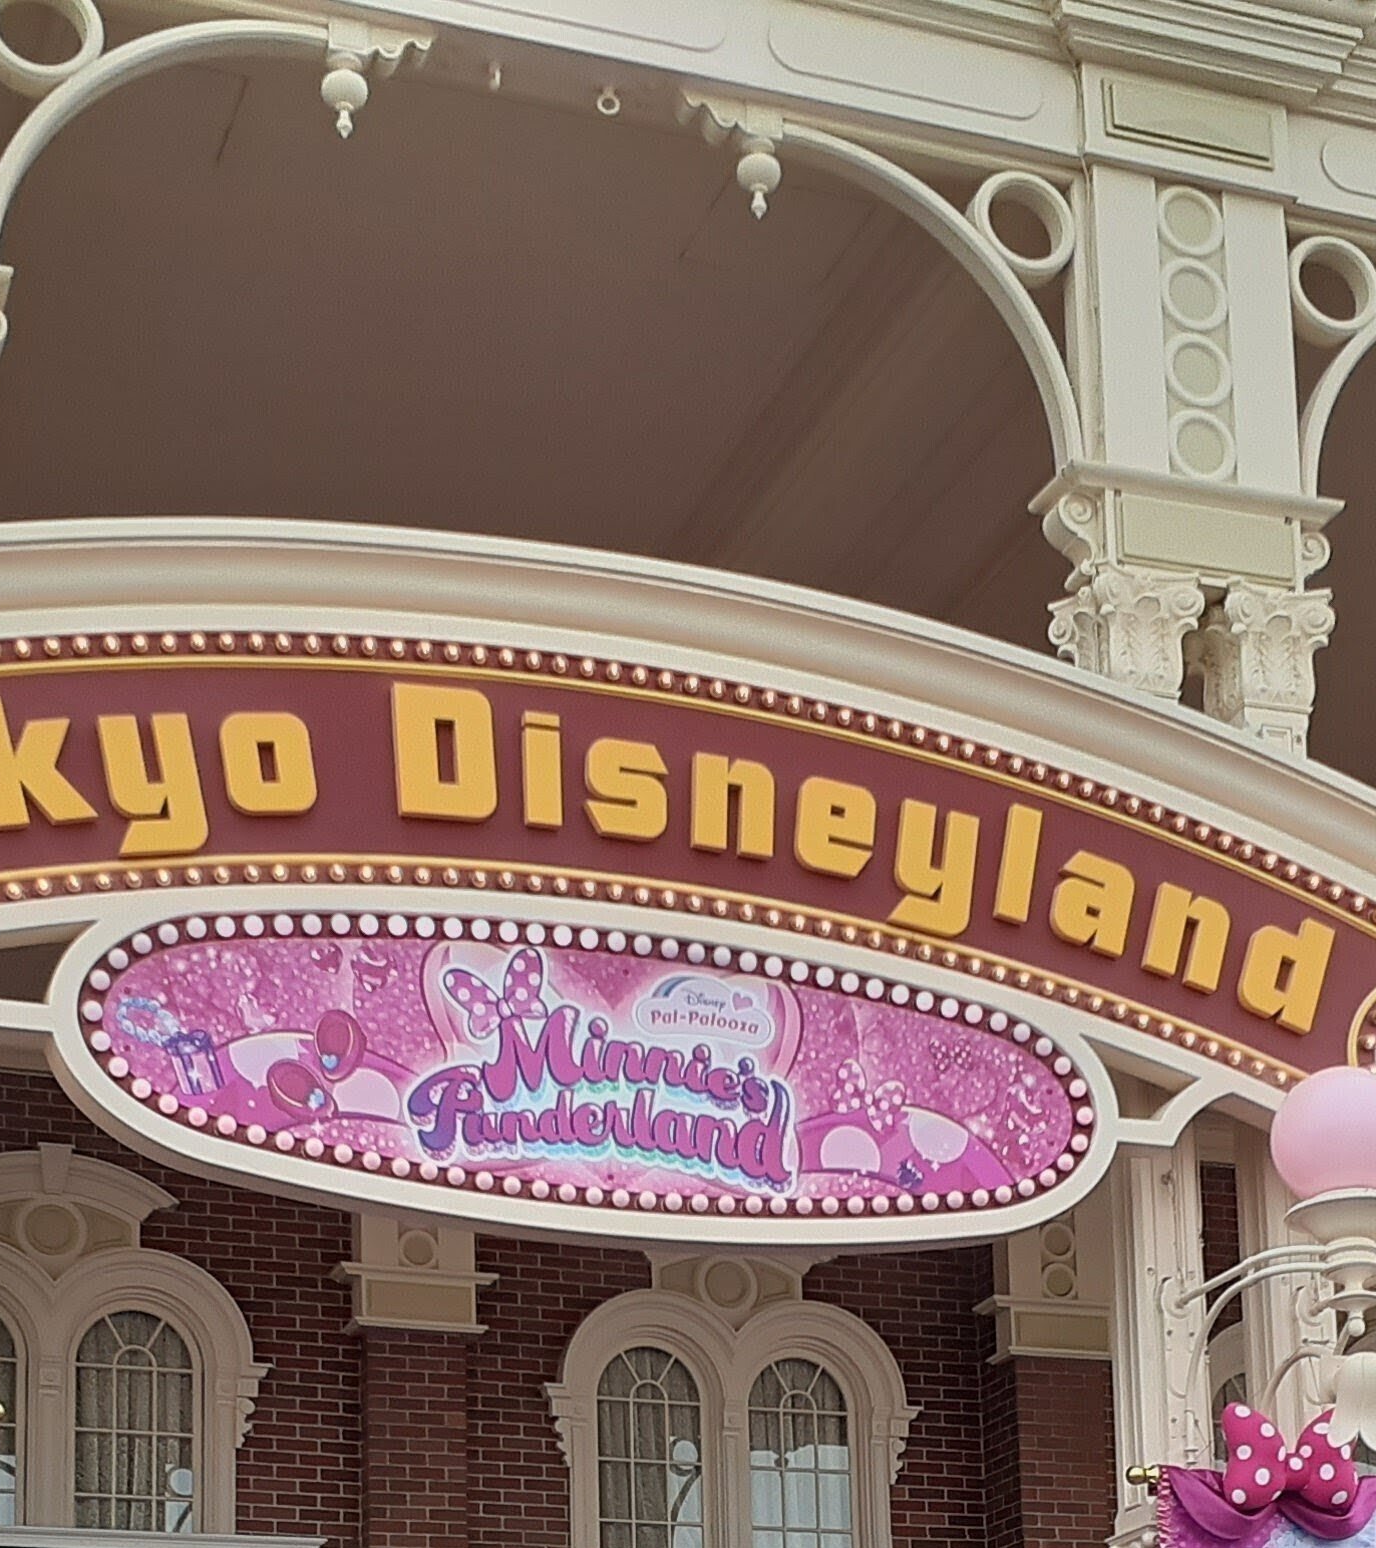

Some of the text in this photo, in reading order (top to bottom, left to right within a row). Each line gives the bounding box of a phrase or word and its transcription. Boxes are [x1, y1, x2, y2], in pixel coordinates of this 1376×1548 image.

[390, 681, 1336, 1036] Disneyland
[649, 1008, 761, 1036] Pal-Palooza
[684, 990, 728, 1012] Disney
[481, 1004, 770, 1114] Minnie's
